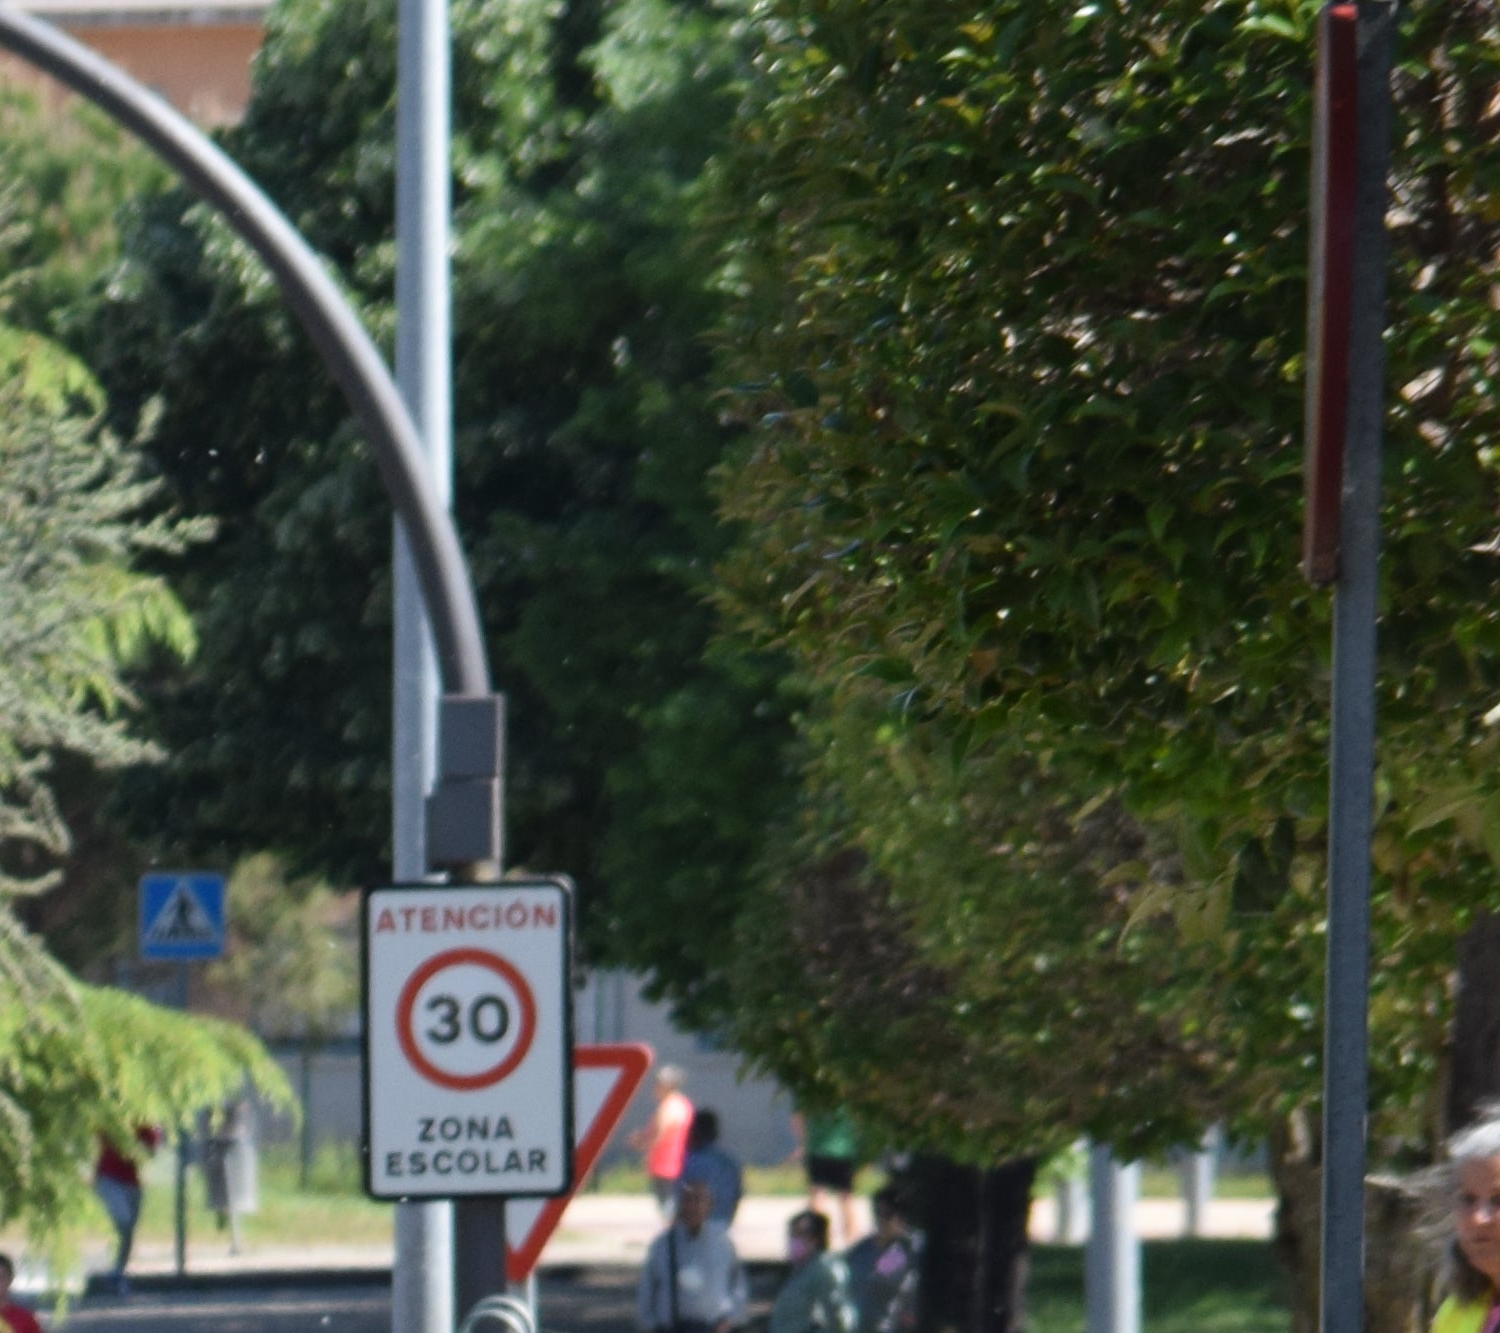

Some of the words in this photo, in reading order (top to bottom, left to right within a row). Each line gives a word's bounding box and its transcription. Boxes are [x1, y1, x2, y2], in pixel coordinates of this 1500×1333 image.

[376, 899, 556, 933] ATENCIÓN
[426, 994, 510, 1044] 30
[418, 1115, 515, 1143] ZONA
[385, 1149, 548, 1178] ESCOLAR
